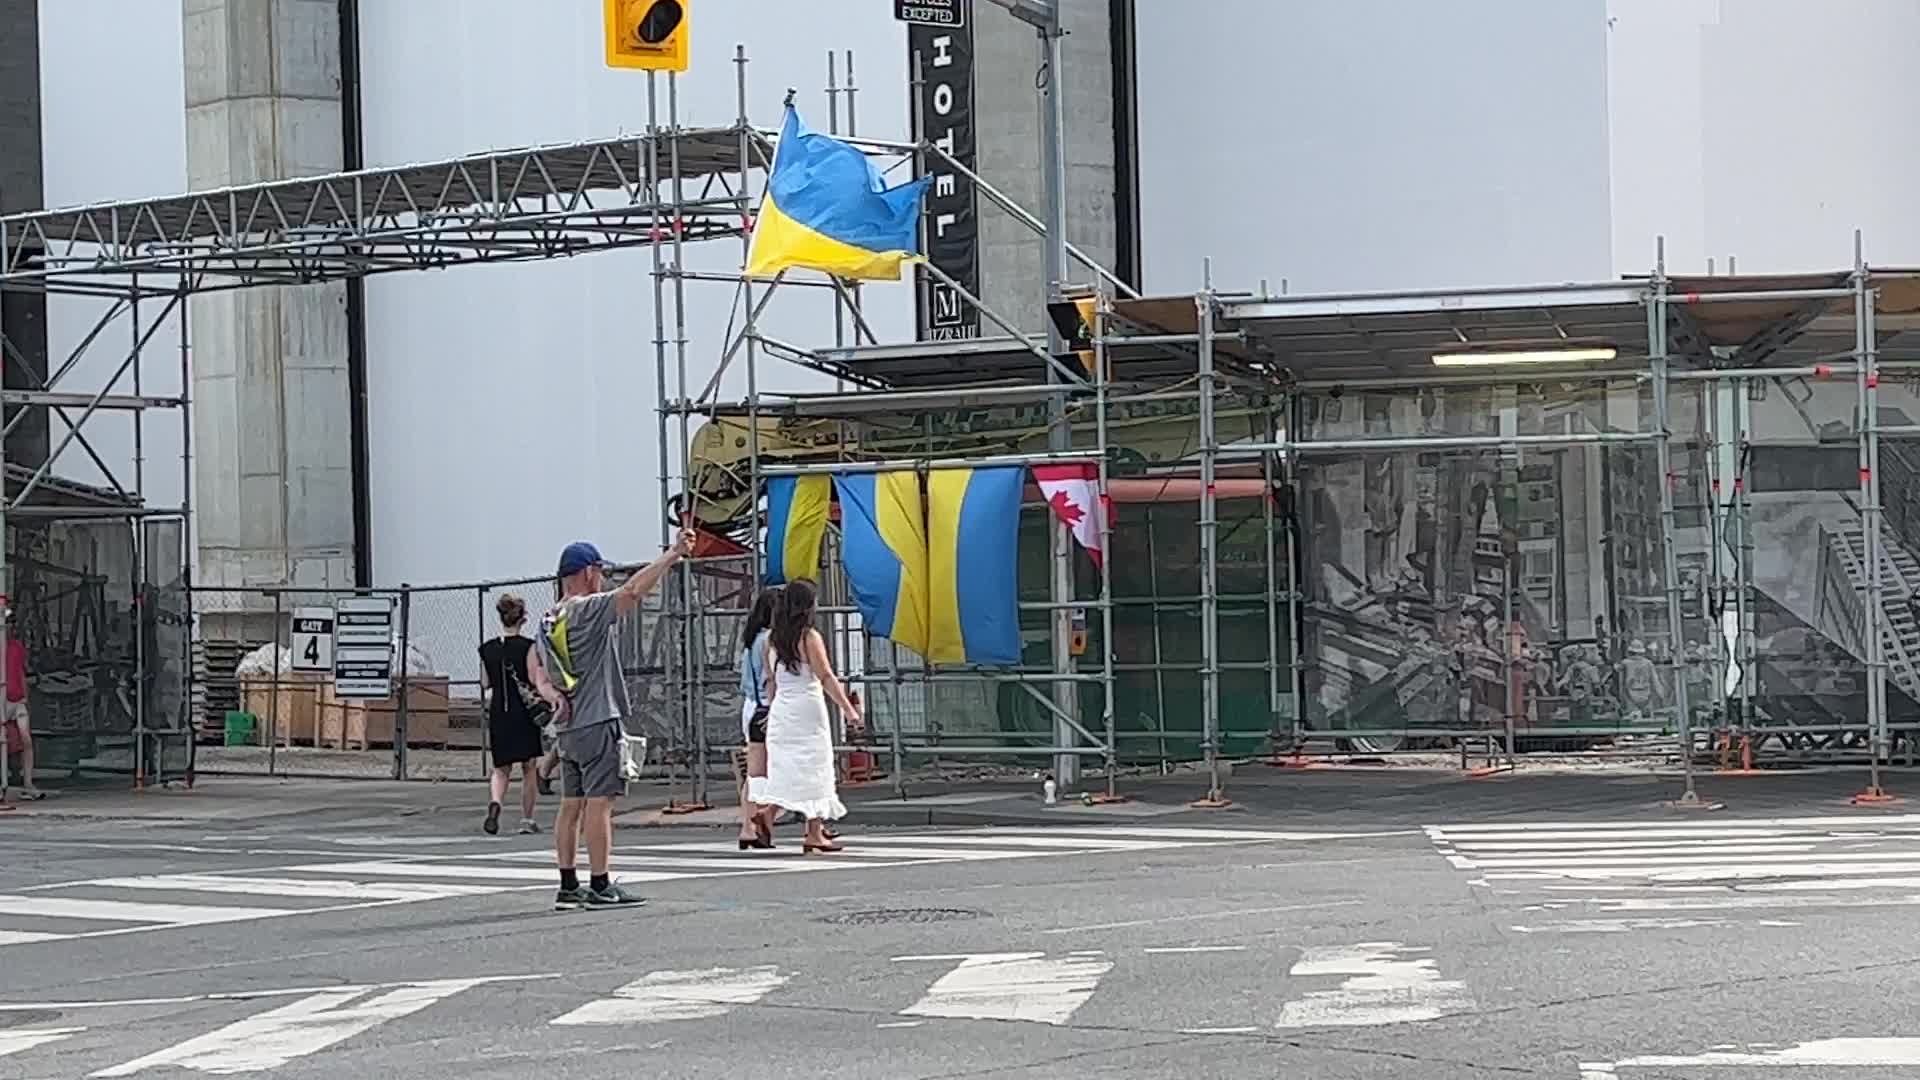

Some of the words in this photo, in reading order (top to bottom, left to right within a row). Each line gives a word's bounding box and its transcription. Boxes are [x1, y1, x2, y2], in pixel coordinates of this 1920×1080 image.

[903, 6, 953, 22] EXCEPTED
[933, 36, 955, 237] HOTEL
[936, 289, 958, 318] M
[304, 635, 319, 665] 4
